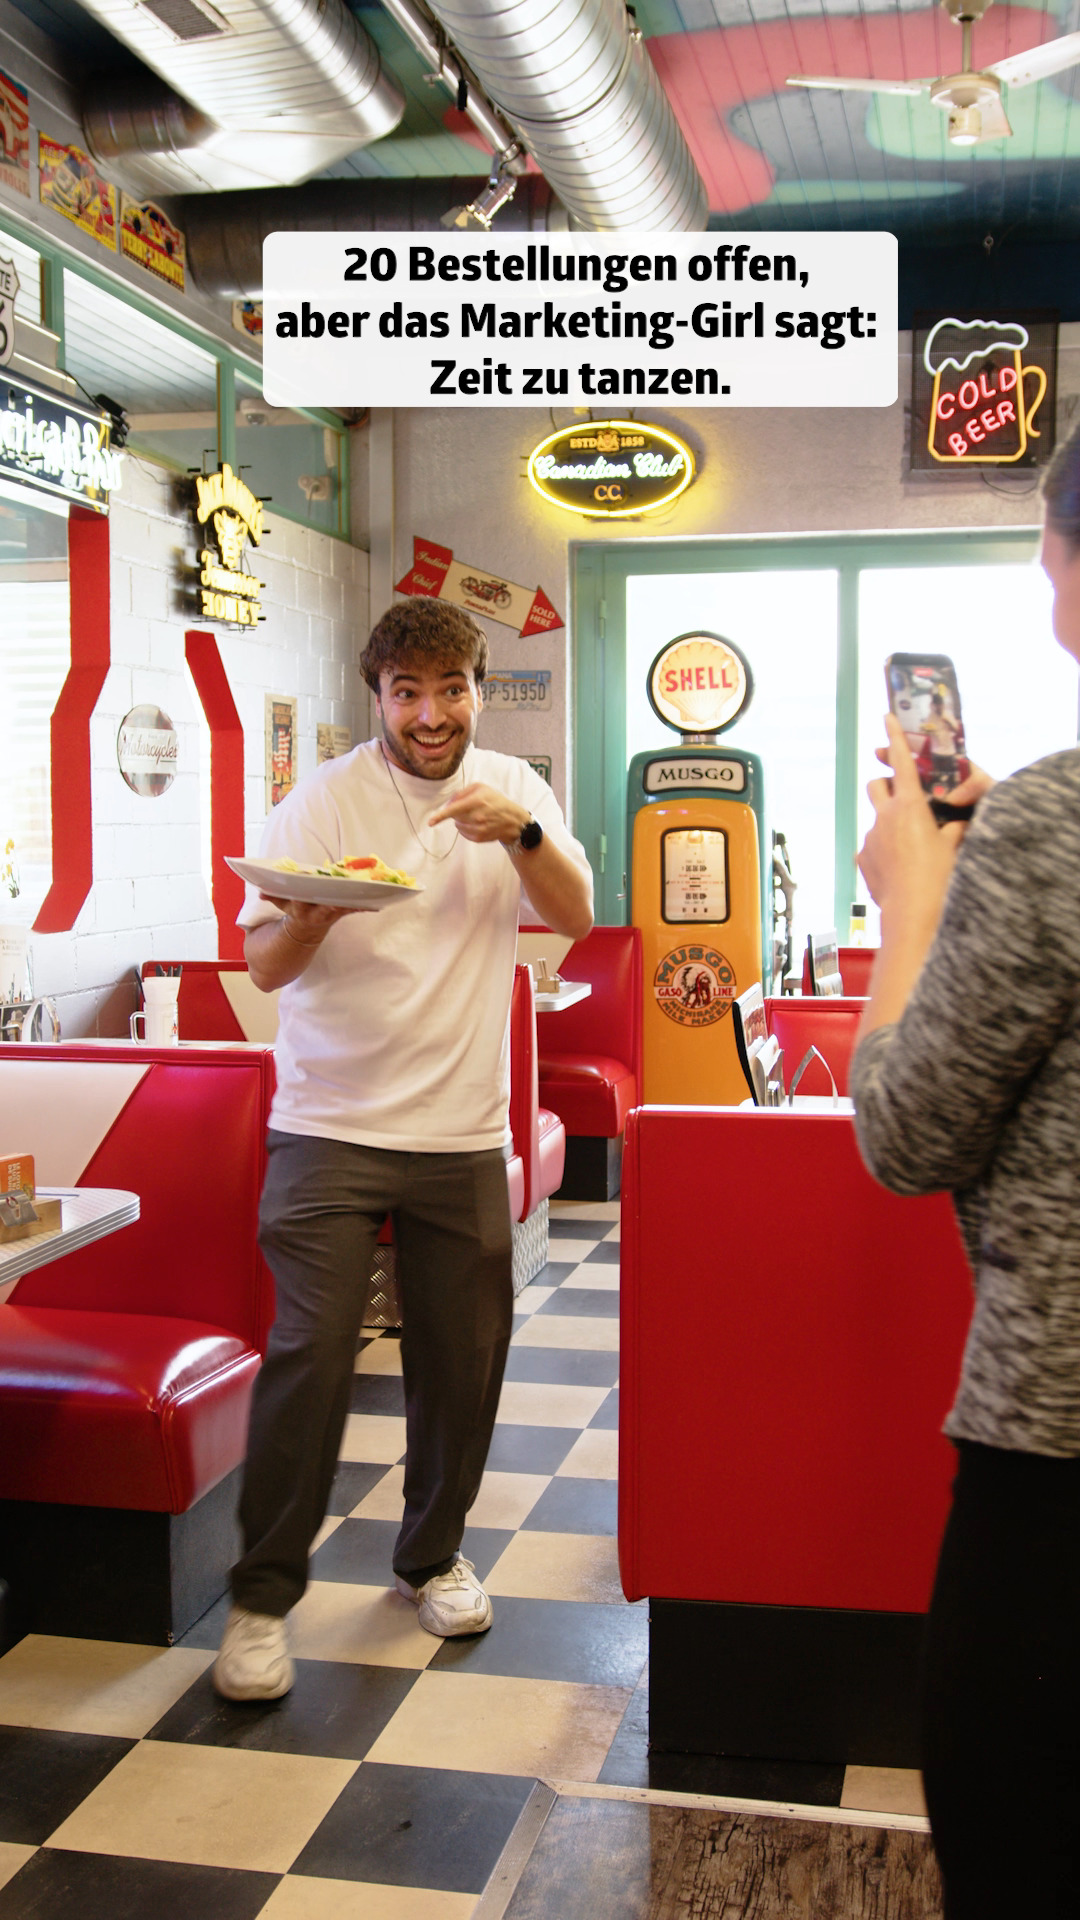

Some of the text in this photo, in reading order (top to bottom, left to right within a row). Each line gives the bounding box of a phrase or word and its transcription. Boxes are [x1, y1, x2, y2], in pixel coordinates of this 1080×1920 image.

[936, 366, 1018, 420] COLD
[948, 400, 1016, 457] BEER
[620, 436, 645, 448] 1858
[534, 452, 685, 480] Canadian Club
[415, 550, 450, 571] Indian
[412, 571, 440, 591] Chief
[529, 614, 553, 628] HERE
[531, 604, 556, 620] SOLD
[664, 666, 733, 692] SHELL
[118, 734, 178, 765] Motorcycles
[657, 767, 735, 783] MUSGO
[657, 947, 733, 984] MUSGO
[658, 987, 734, 997] GASO LINE
